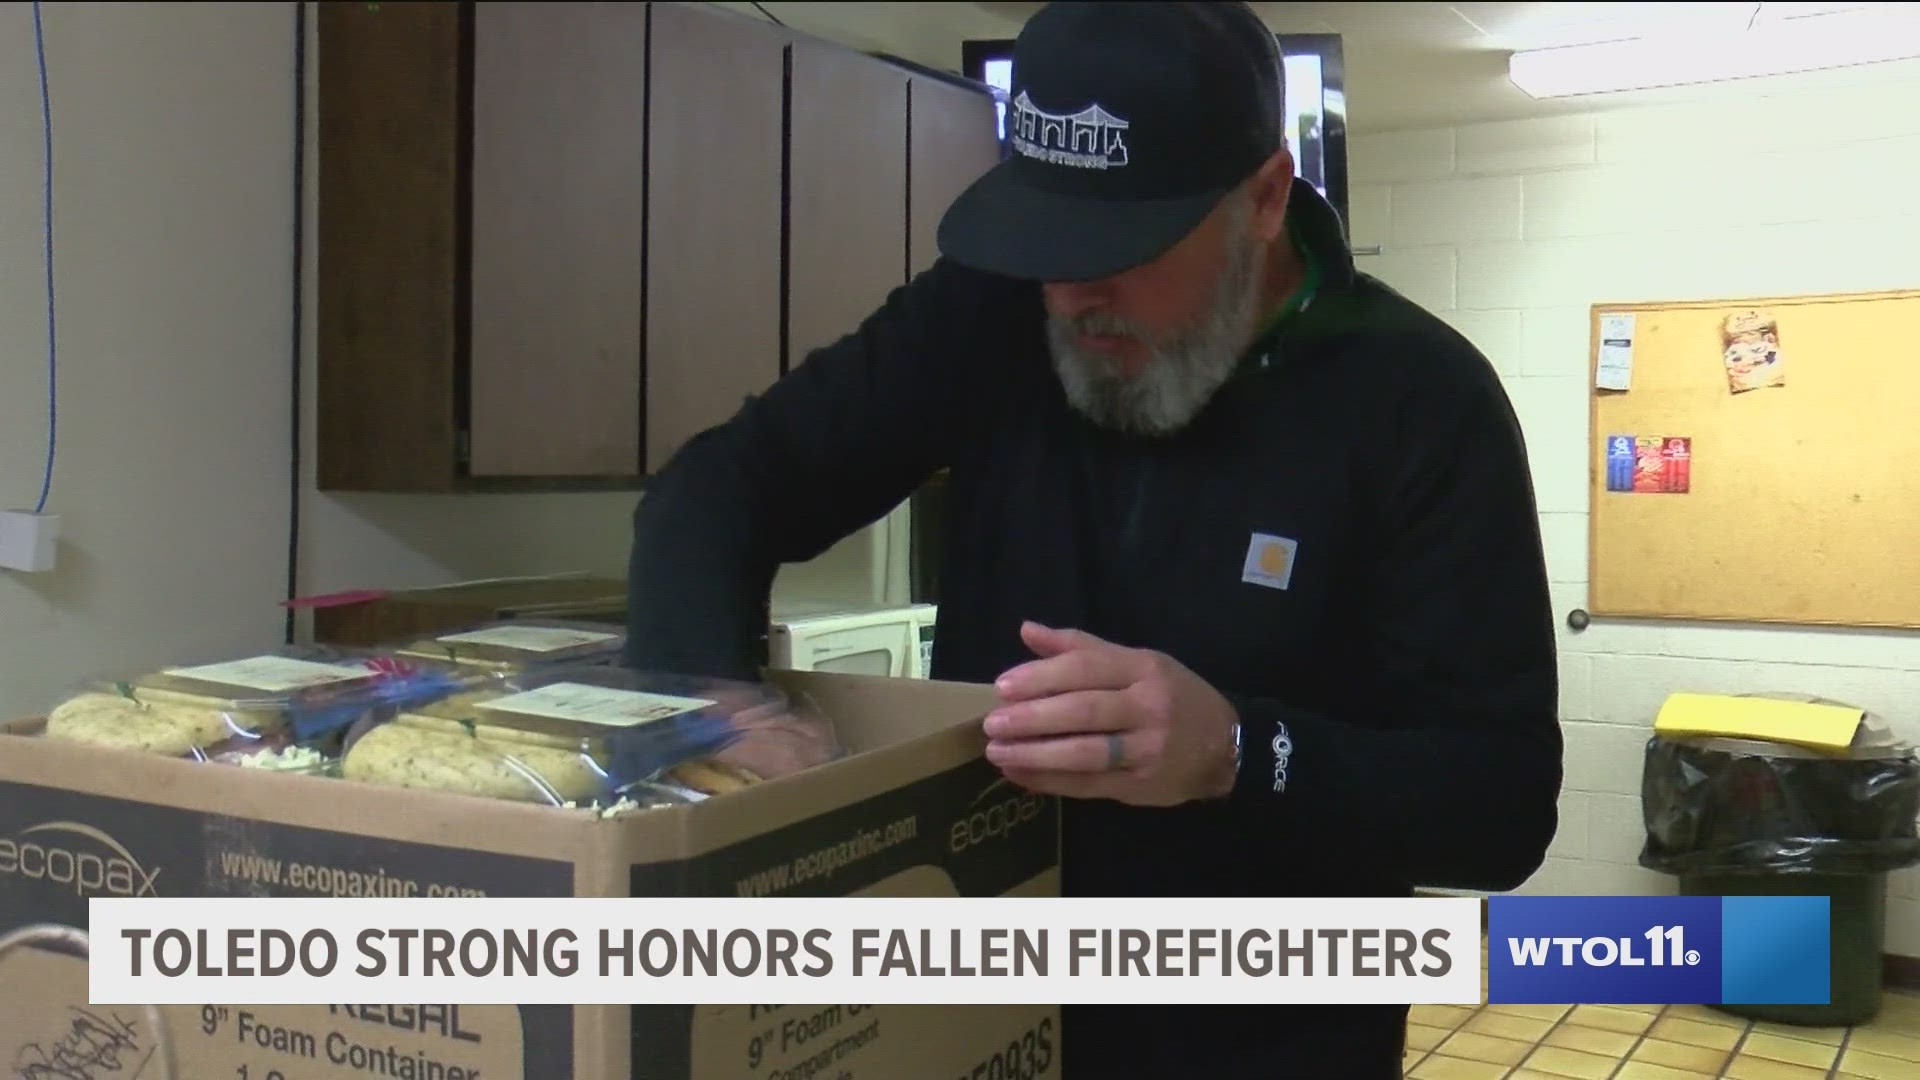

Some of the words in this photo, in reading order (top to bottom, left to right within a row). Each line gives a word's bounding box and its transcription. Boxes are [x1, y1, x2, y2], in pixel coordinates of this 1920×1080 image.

[1272, 720, 1293, 792] FORCE
[238, 1011, 316, 1059] Foam
[782, 1003, 842, 1053] Foam
